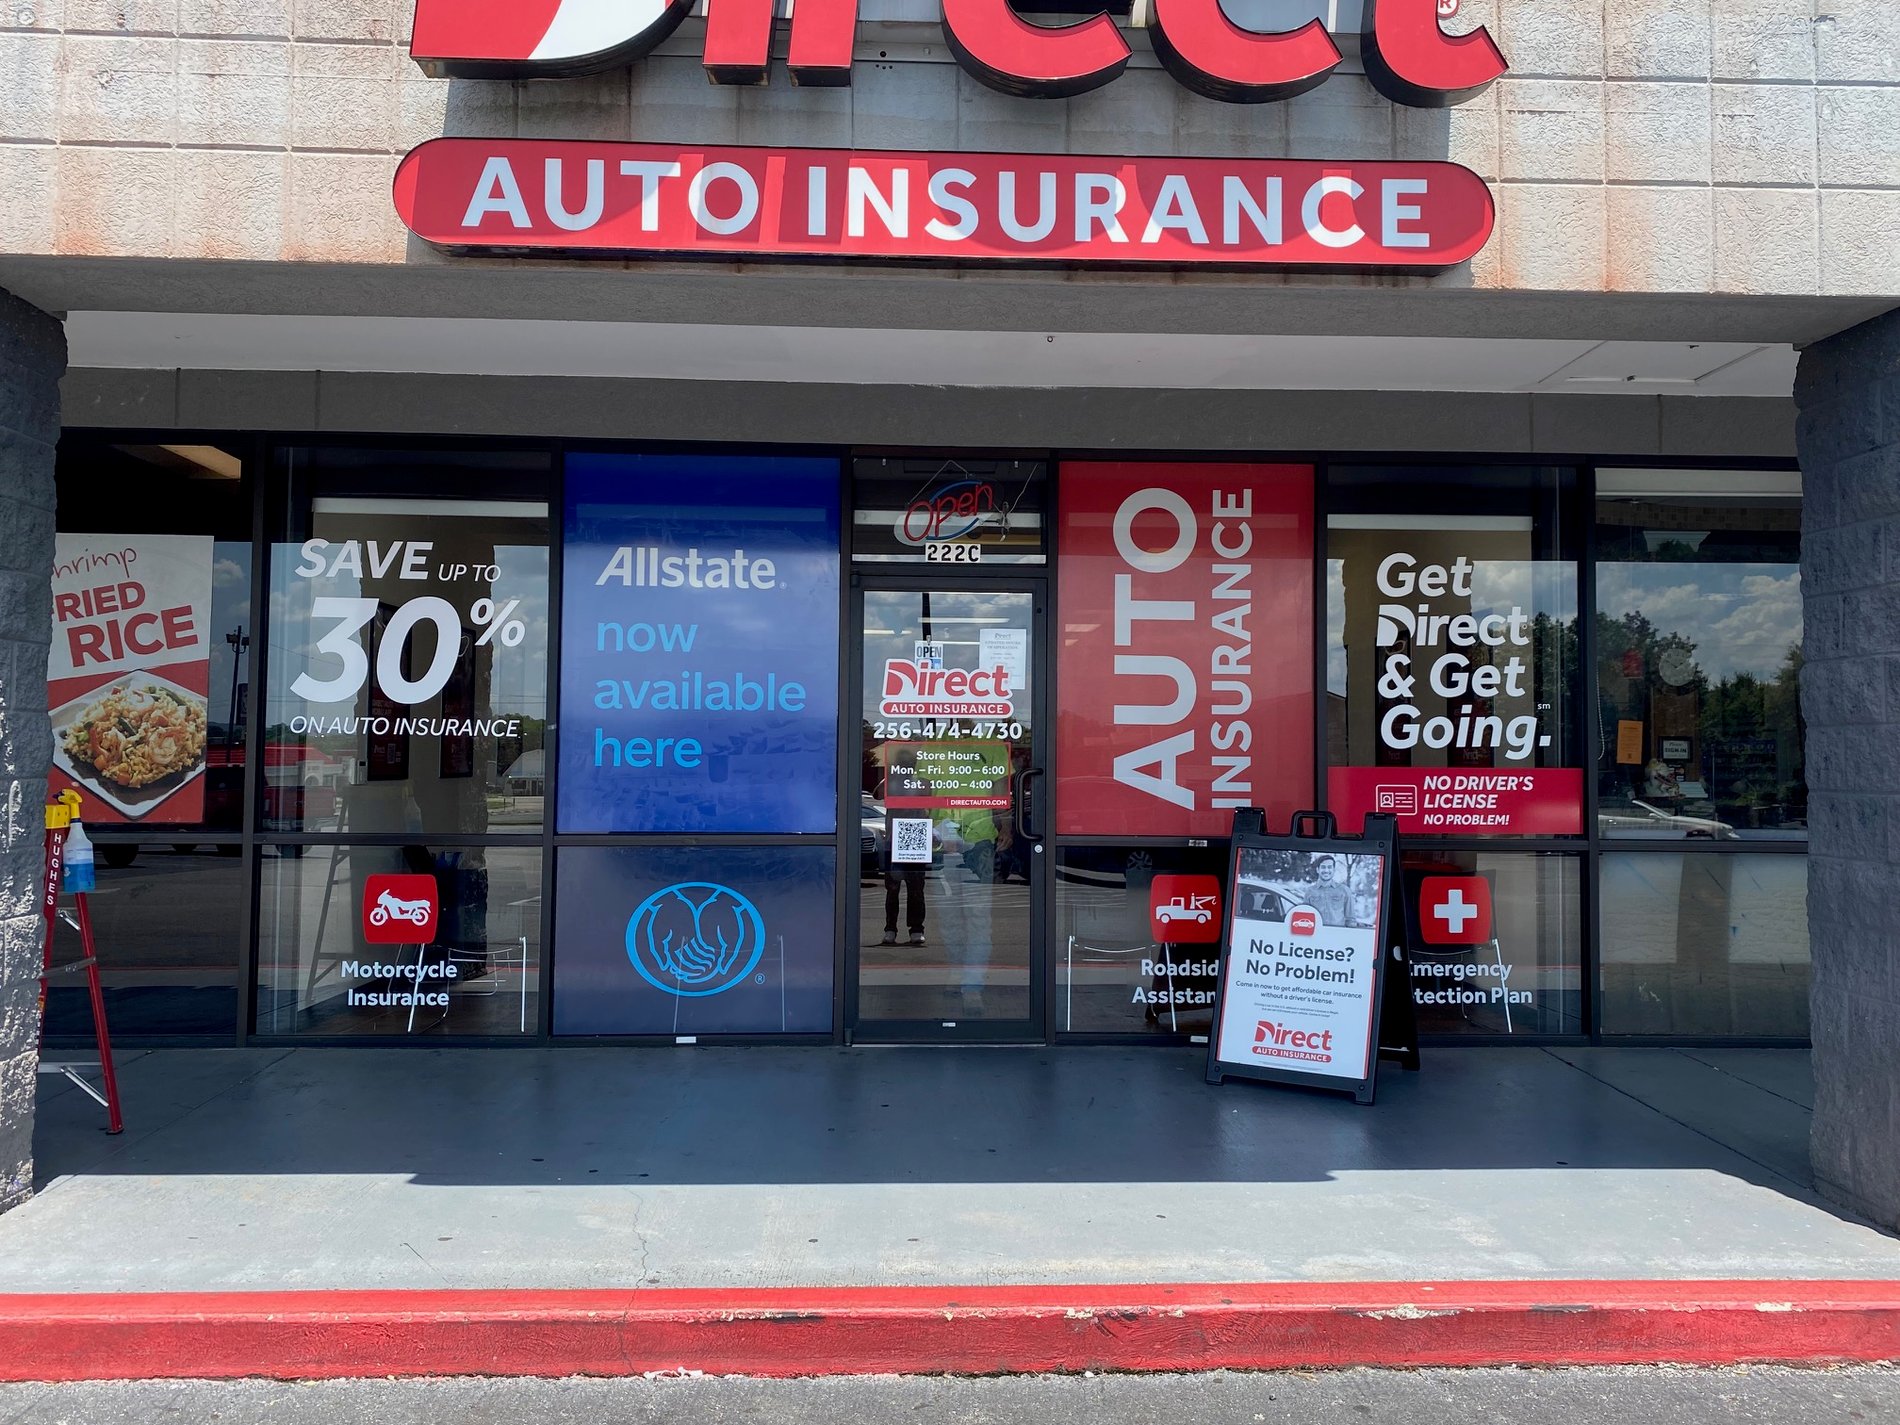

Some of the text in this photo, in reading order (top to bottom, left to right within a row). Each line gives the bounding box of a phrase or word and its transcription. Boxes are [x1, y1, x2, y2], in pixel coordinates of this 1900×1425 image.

[461, 157, 1430, 249] AUTO INSURANCE
[904, 484, 993, 541] Open
[53, 547, 137, 578] hrimp
[294, 538, 501, 582] SAVE UP TO
[927, 544, 980, 562] 222C
[595, 546, 776, 589] Allstate
[1376, 552, 1473, 597] Get
[52, 581, 146, 622] RIED
[67, 605, 199, 668] RICE
[597, 622, 698, 652] now
[1376, 603, 1530, 646] Direct
[917, 646, 942, 657] OPEN
[1113, 487, 1198, 811] AUTO
[1210, 488, 1253, 809] INSURANCE
[885, 661, 1010, 697] Direct
[1377, 653, 1526, 699] & Get
[594, 670, 806, 711] available
[890, 703, 1004, 714] AUTO INSURANCE
[290, 716, 521, 737] ON AUTO INSURANCE
[873, 722, 1023, 740] 256-474-4730
[1380, 704, 1551, 760] Going.
[594, 727, 703, 767] here
[916, 751, 980, 760] Store Hours
[890, 766, 917, 774] Mon.
[927, 766, 945, 774] Fri.
[949, 766, 972, 775] 9:00
[981, 766, 1005, 775] 6:00
[1423, 776, 1451, 790] NO
[903, 780, 925, 789] Sat.
[929, 780, 959, 789] 10:00
[969, 780, 993, 789] 4:00
[1423, 794, 1498, 809] LICENSE
[1423, 814, 1510, 825] NO PROBLEM!
[46, 833, 62, 905] HUGHES
[1249, 939, 1355, 962] No License?
[341, 960, 458, 983] Motorcycle
[1141, 959, 1219, 976] Roadsid
[1246, 959, 1355, 984] No Problem!
[347, 988, 450, 1006] Insurance
[1131, 986, 1216, 1003] Assistan
[1291, 986, 1321, 995] affordable
[1333, 990, 1362, 999] insurance
[1414, 987, 1533, 1004] tection Plan
[1254, 1020, 1332, 1051] Direct
[1256, 1047, 1328, 1062] AUTO INSURANCE
